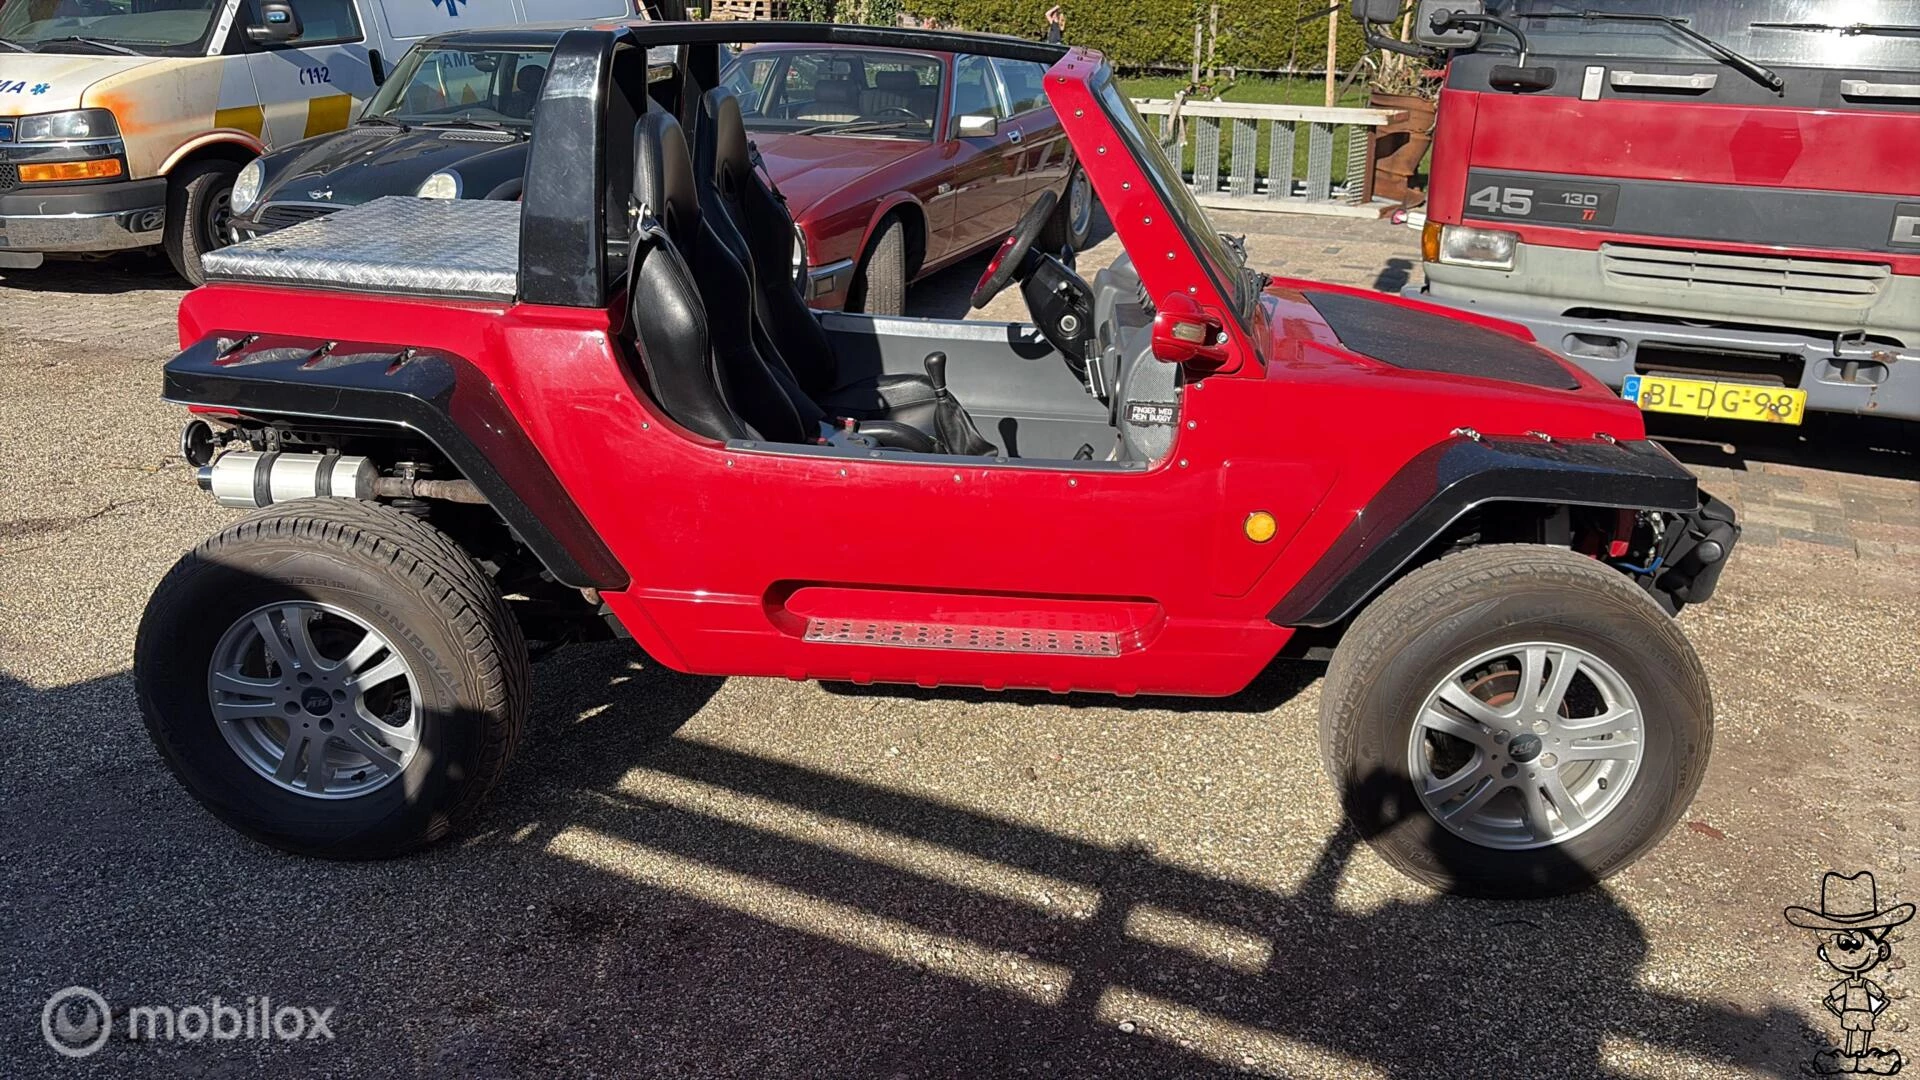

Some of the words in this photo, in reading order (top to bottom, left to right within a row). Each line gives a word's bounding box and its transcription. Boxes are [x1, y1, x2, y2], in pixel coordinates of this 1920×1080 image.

[1469, 186, 1533, 215] 45
[1561, 193, 1598, 206] 130
[1132, 406, 1156, 414] FINGER
[1649, 383, 1793, 417] BL-DG-98
[1149, 414, 1172, 422] BUGGY
[374, 604, 463, 696] UNIROYAL
